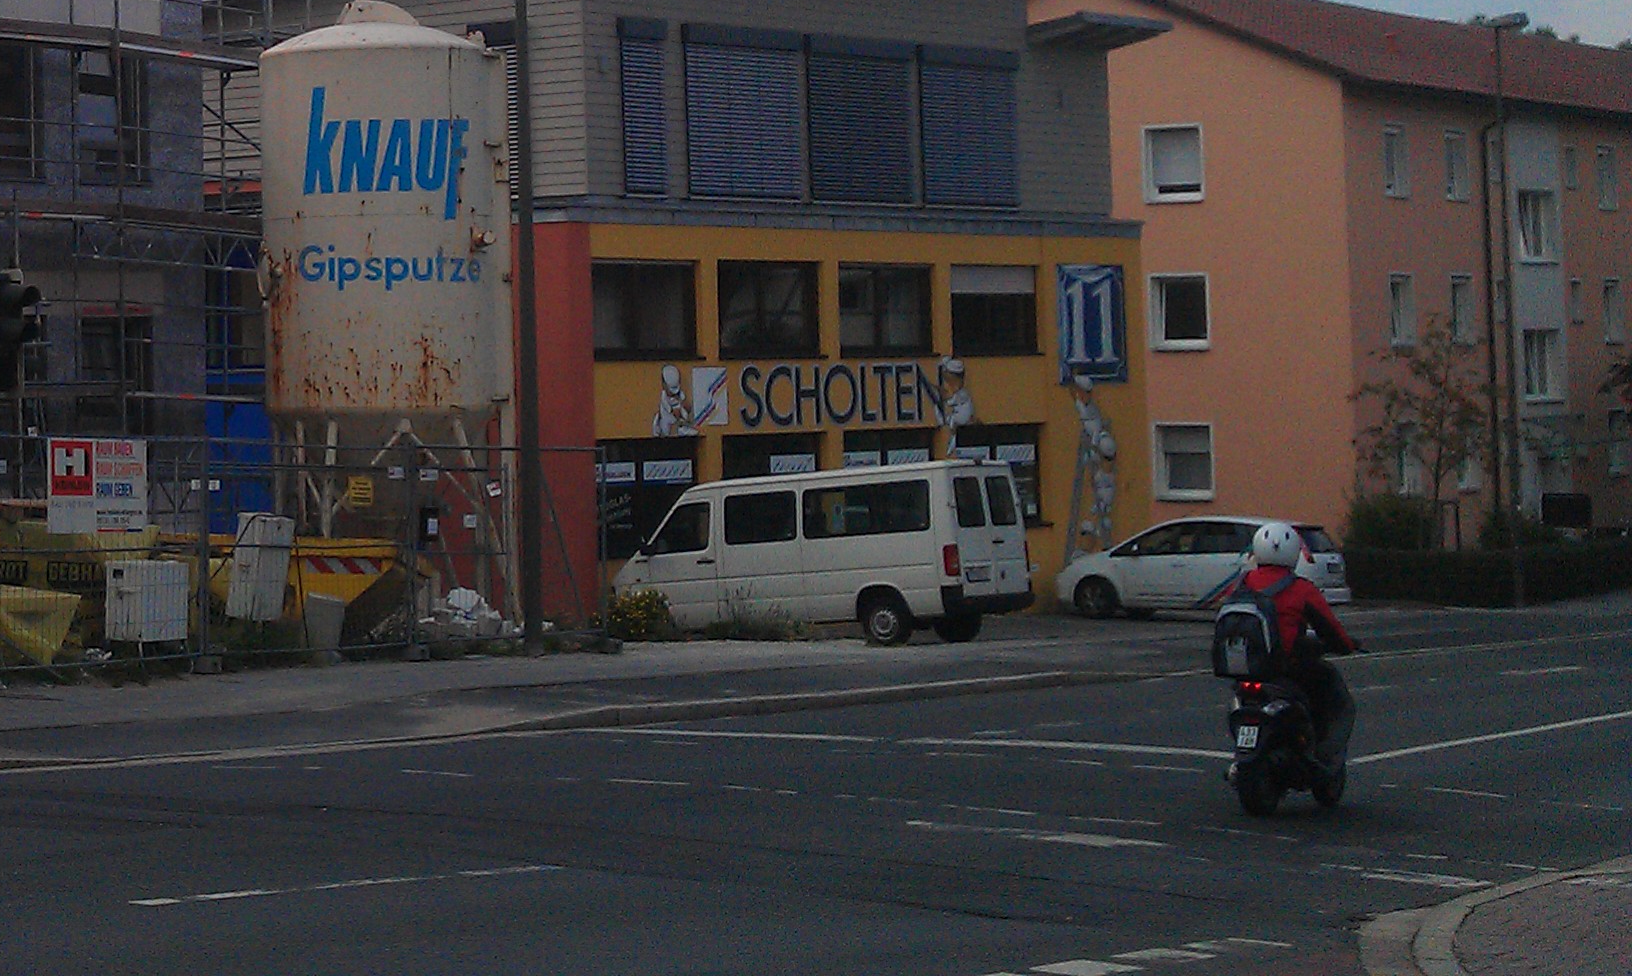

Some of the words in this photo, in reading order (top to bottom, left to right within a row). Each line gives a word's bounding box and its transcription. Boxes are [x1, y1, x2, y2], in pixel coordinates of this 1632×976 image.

[302, 85, 470, 221] KNAUF
[297, 244, 482, 292] Gipsputze
[1066, 279, 1120, 363] 11
[739, 362, 946, 427] SCHOLTEN
